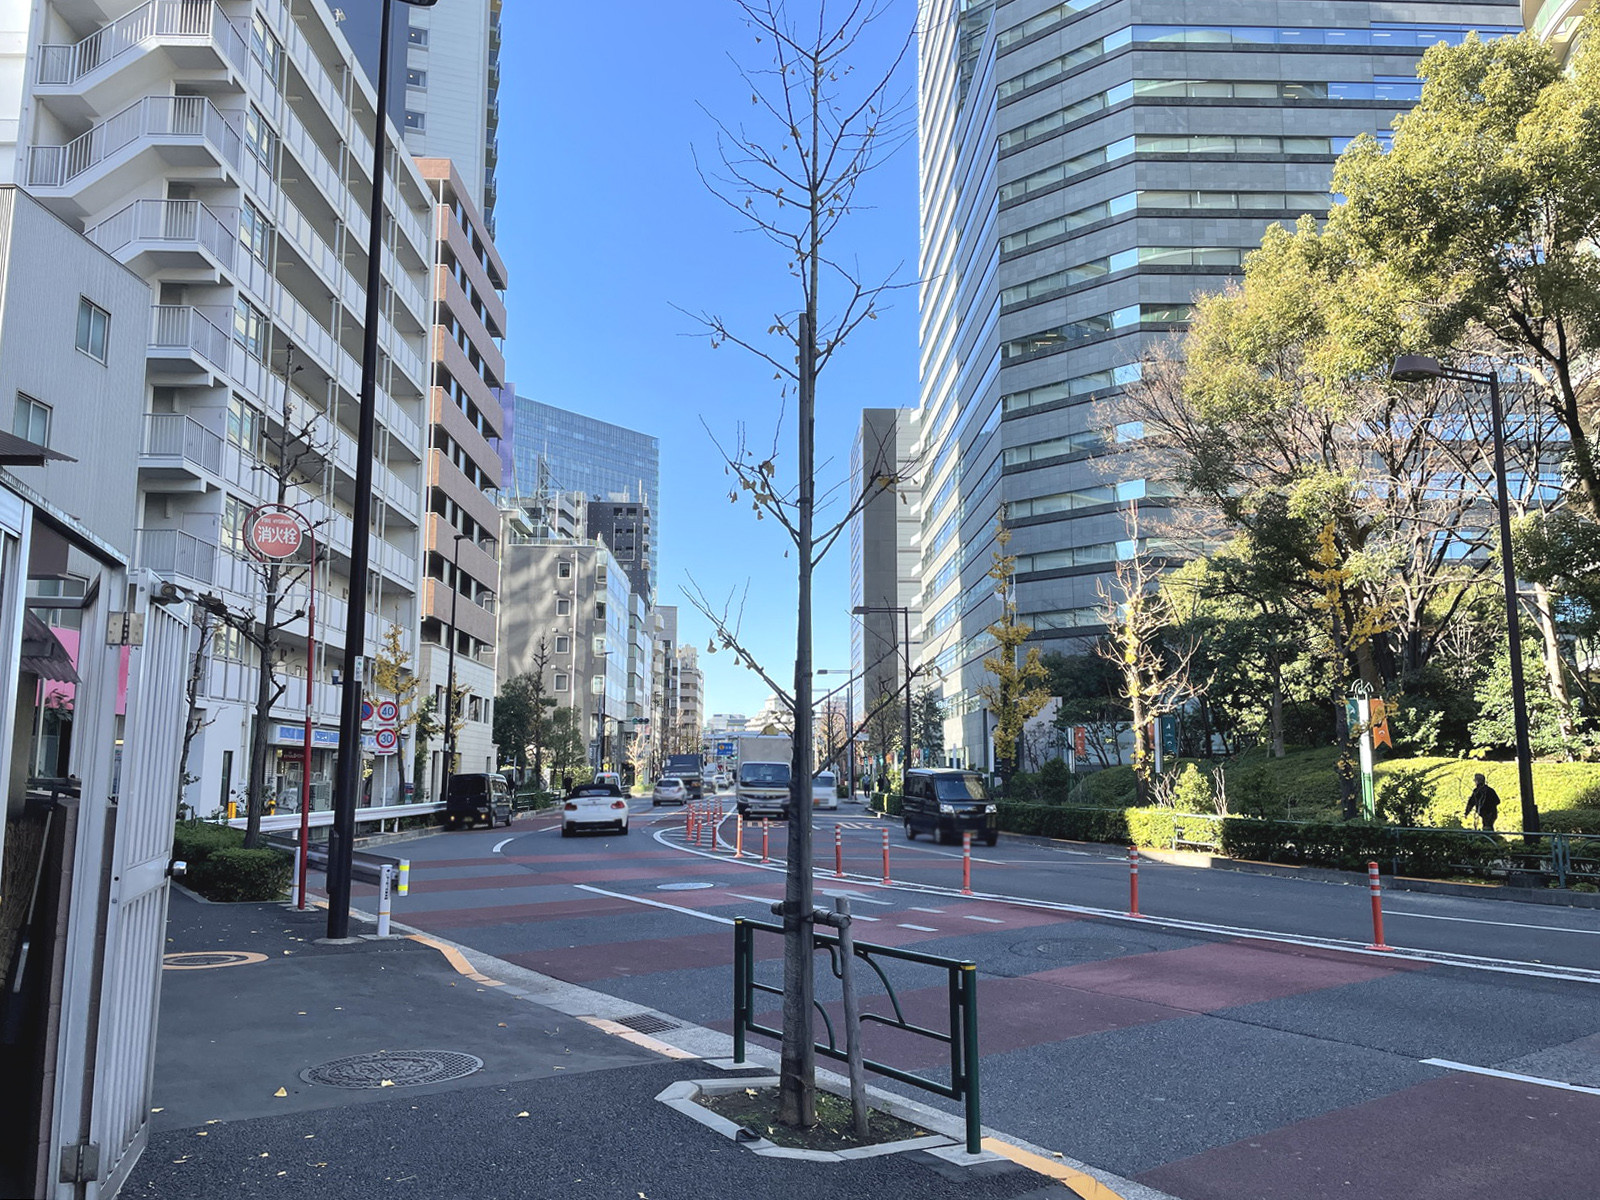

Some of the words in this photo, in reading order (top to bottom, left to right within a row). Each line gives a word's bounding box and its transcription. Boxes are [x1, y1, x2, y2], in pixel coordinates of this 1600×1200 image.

[258, 525, 298, 545] 消火栓
[381, 706, 394, 716] 40
[380, 733, 393, 743] 30
